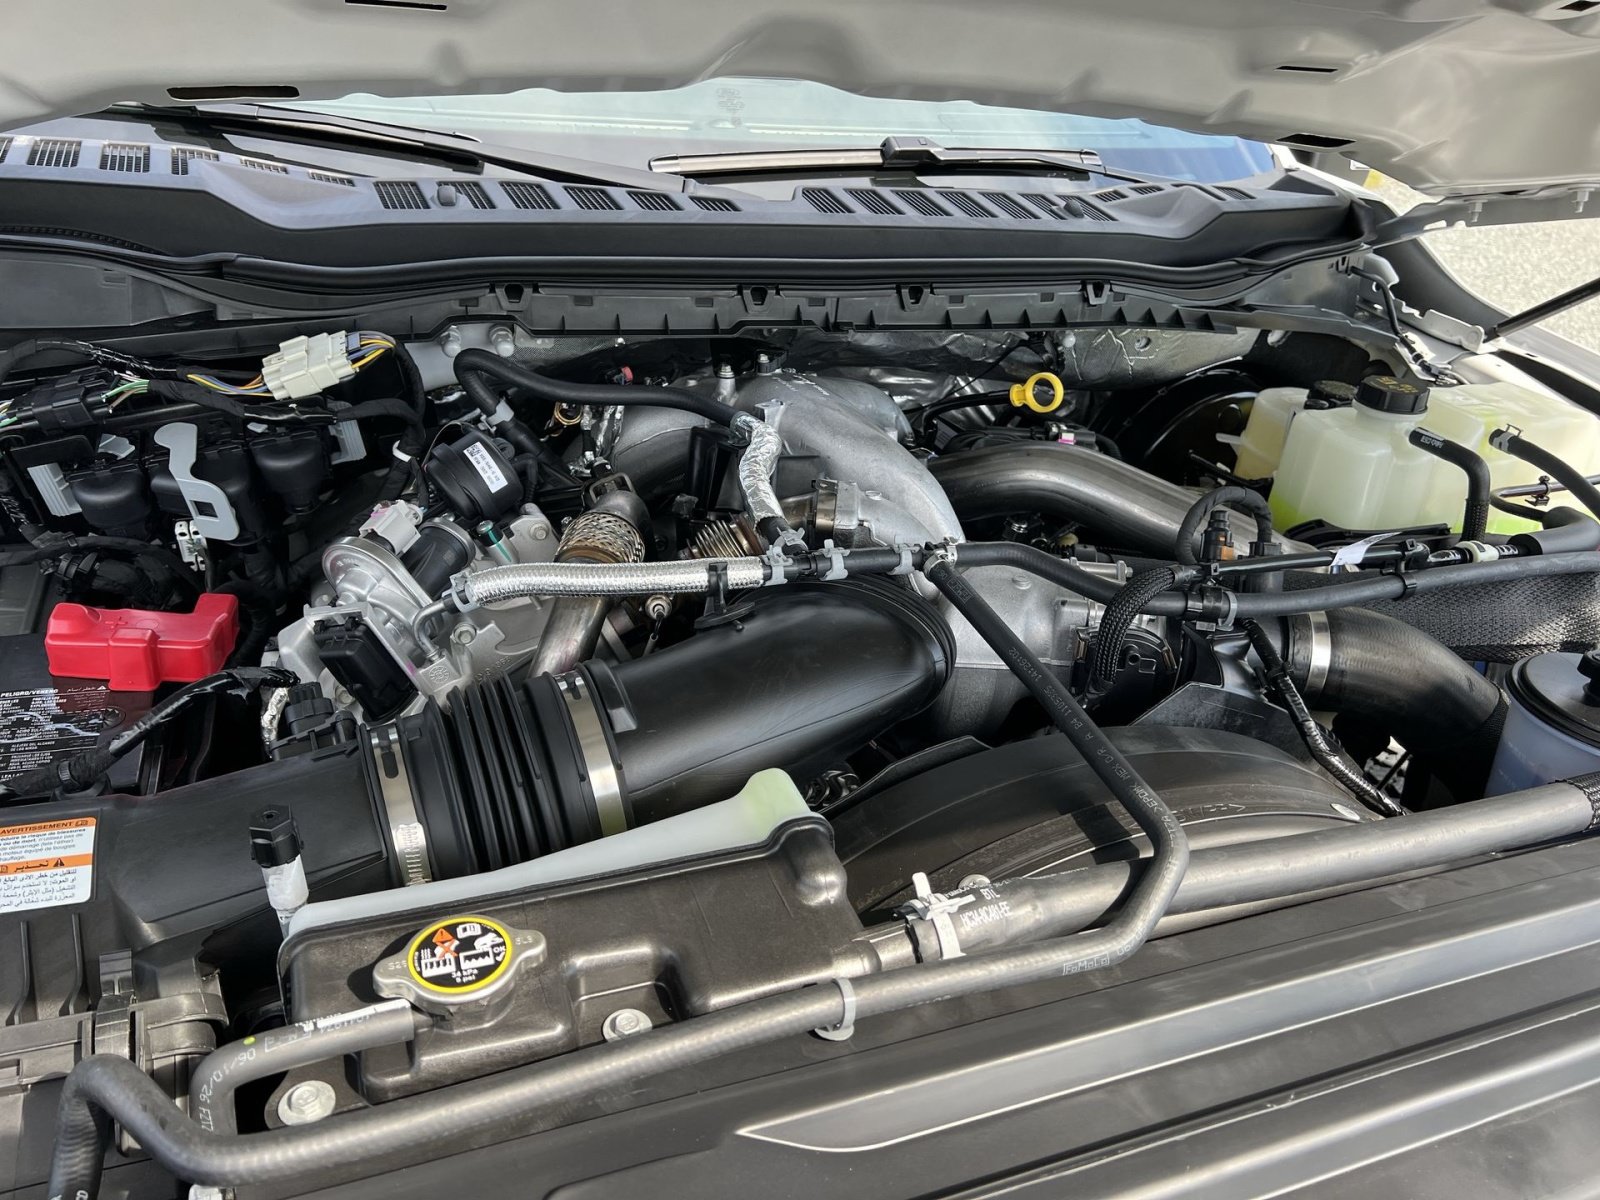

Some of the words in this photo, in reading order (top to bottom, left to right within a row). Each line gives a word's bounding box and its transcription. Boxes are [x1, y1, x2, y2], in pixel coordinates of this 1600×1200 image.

[1, 689, 58, 698] PELIGRO/VENENO
[1112, 763, 1131, 781] MEX
[1, 822, 72, 835] AVERTISSEMENT
[494, 945, 507, 954] OK
[462, 967, 479, 977] kPa
